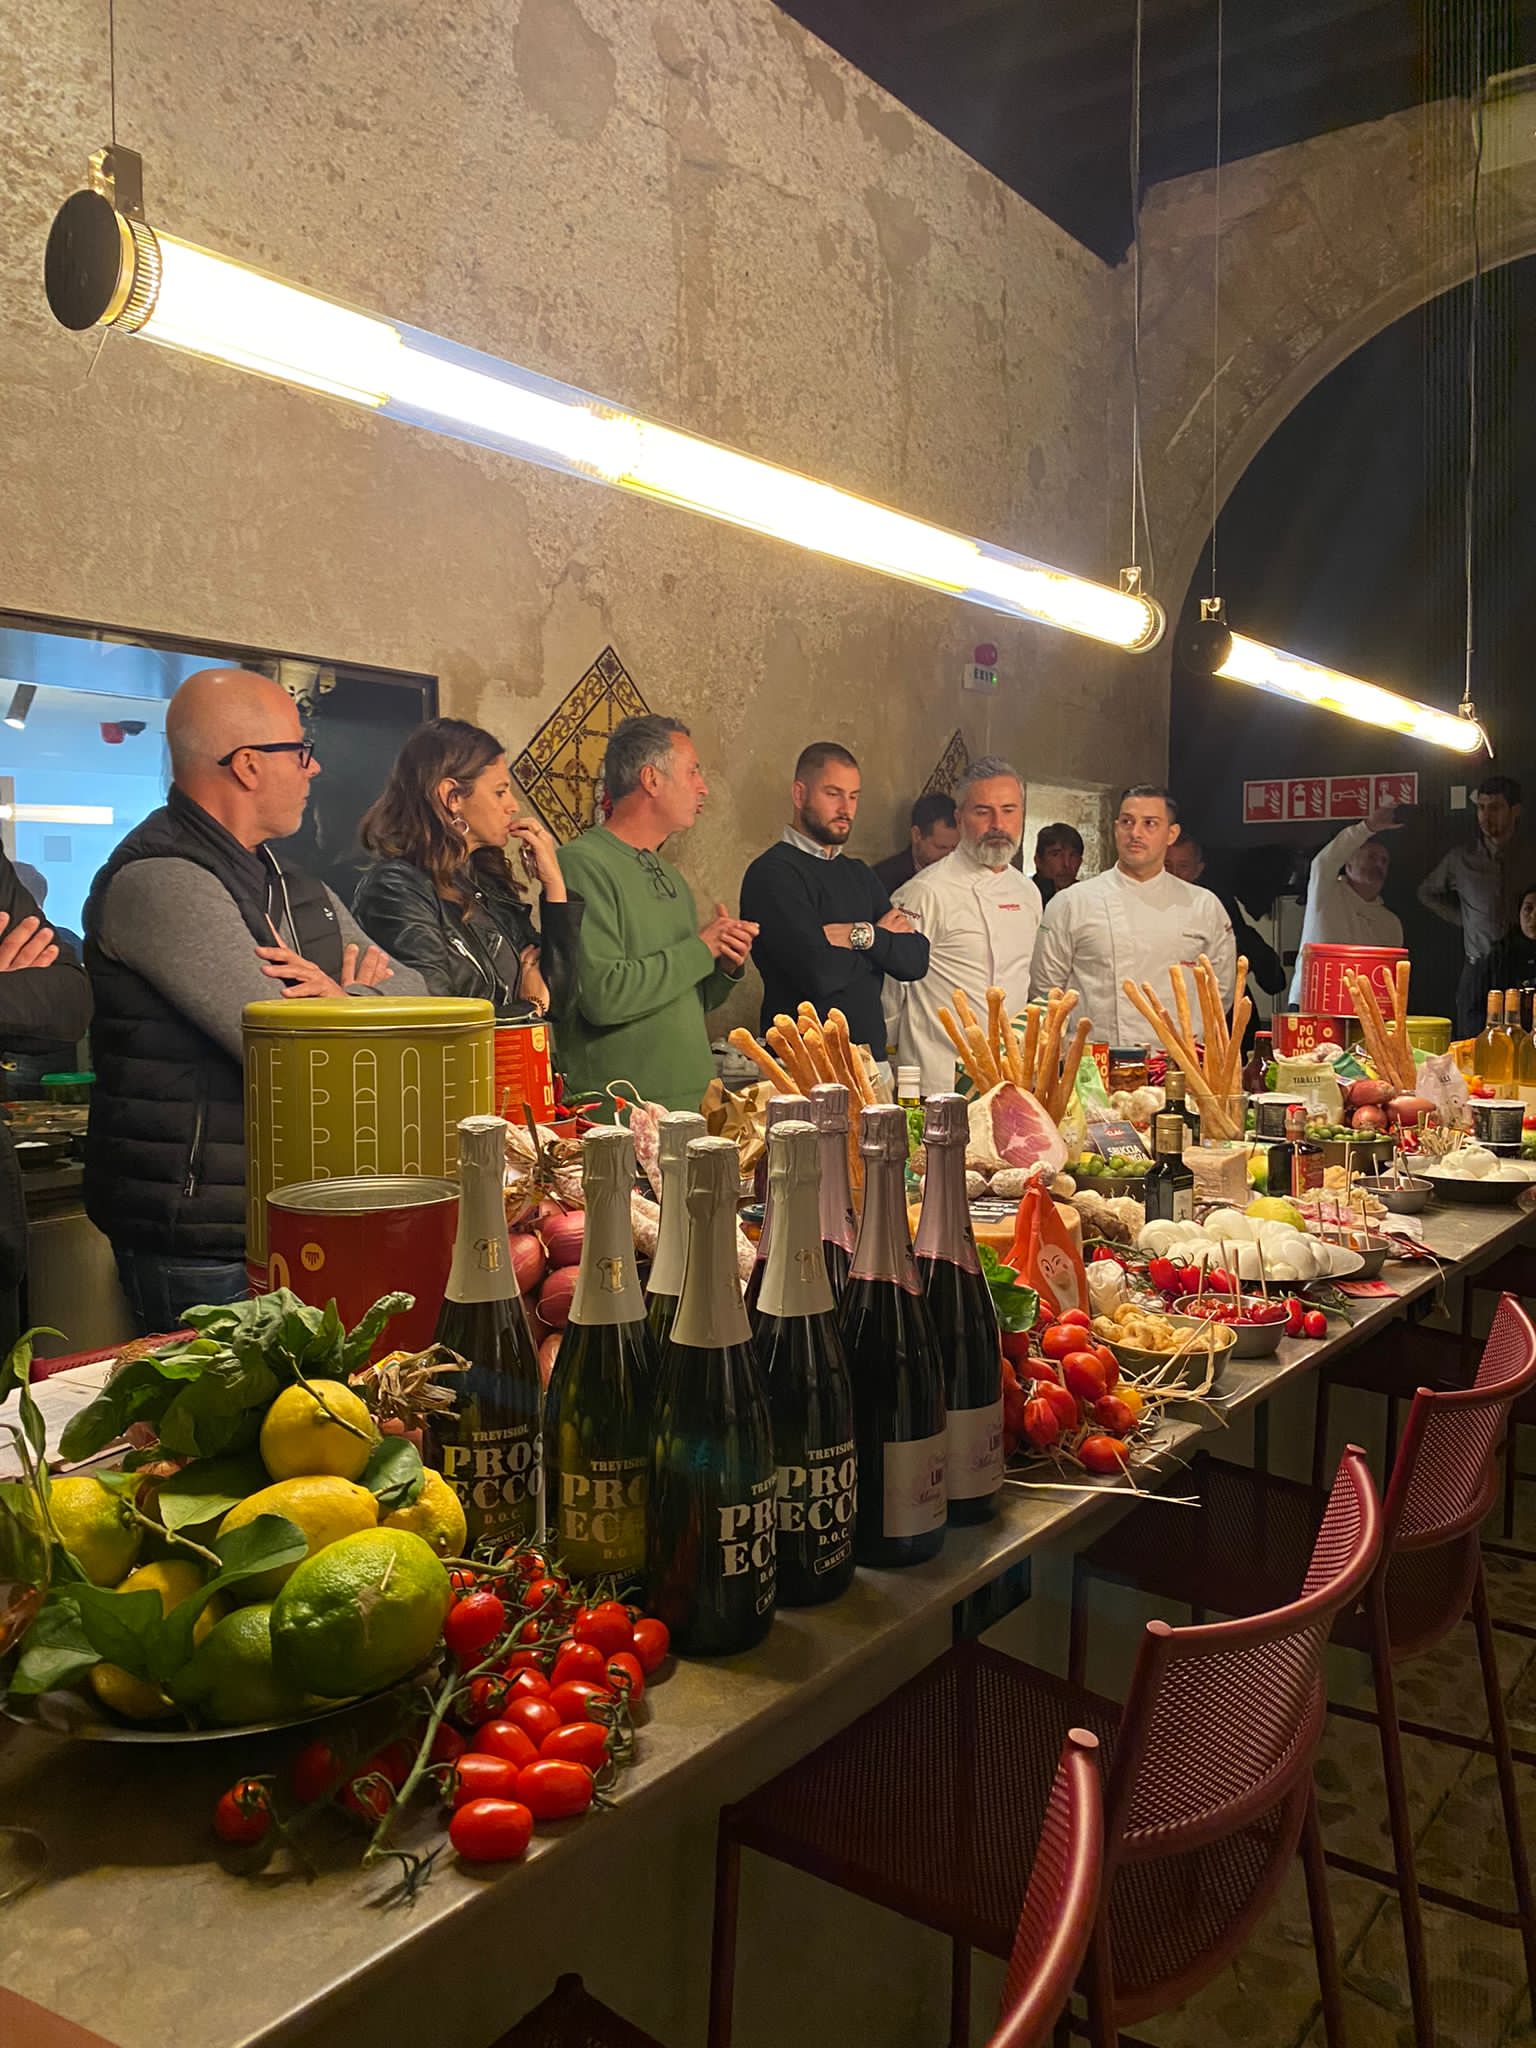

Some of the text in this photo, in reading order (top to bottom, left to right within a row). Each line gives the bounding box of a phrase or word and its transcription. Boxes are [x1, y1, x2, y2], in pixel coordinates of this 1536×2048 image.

[974, 668, 996, 682] EXIT
[441, 1432, 544, 1477] PROS
[717, 1492, 777, 1542] PR
[722, 1529, 776, 1577] EC
